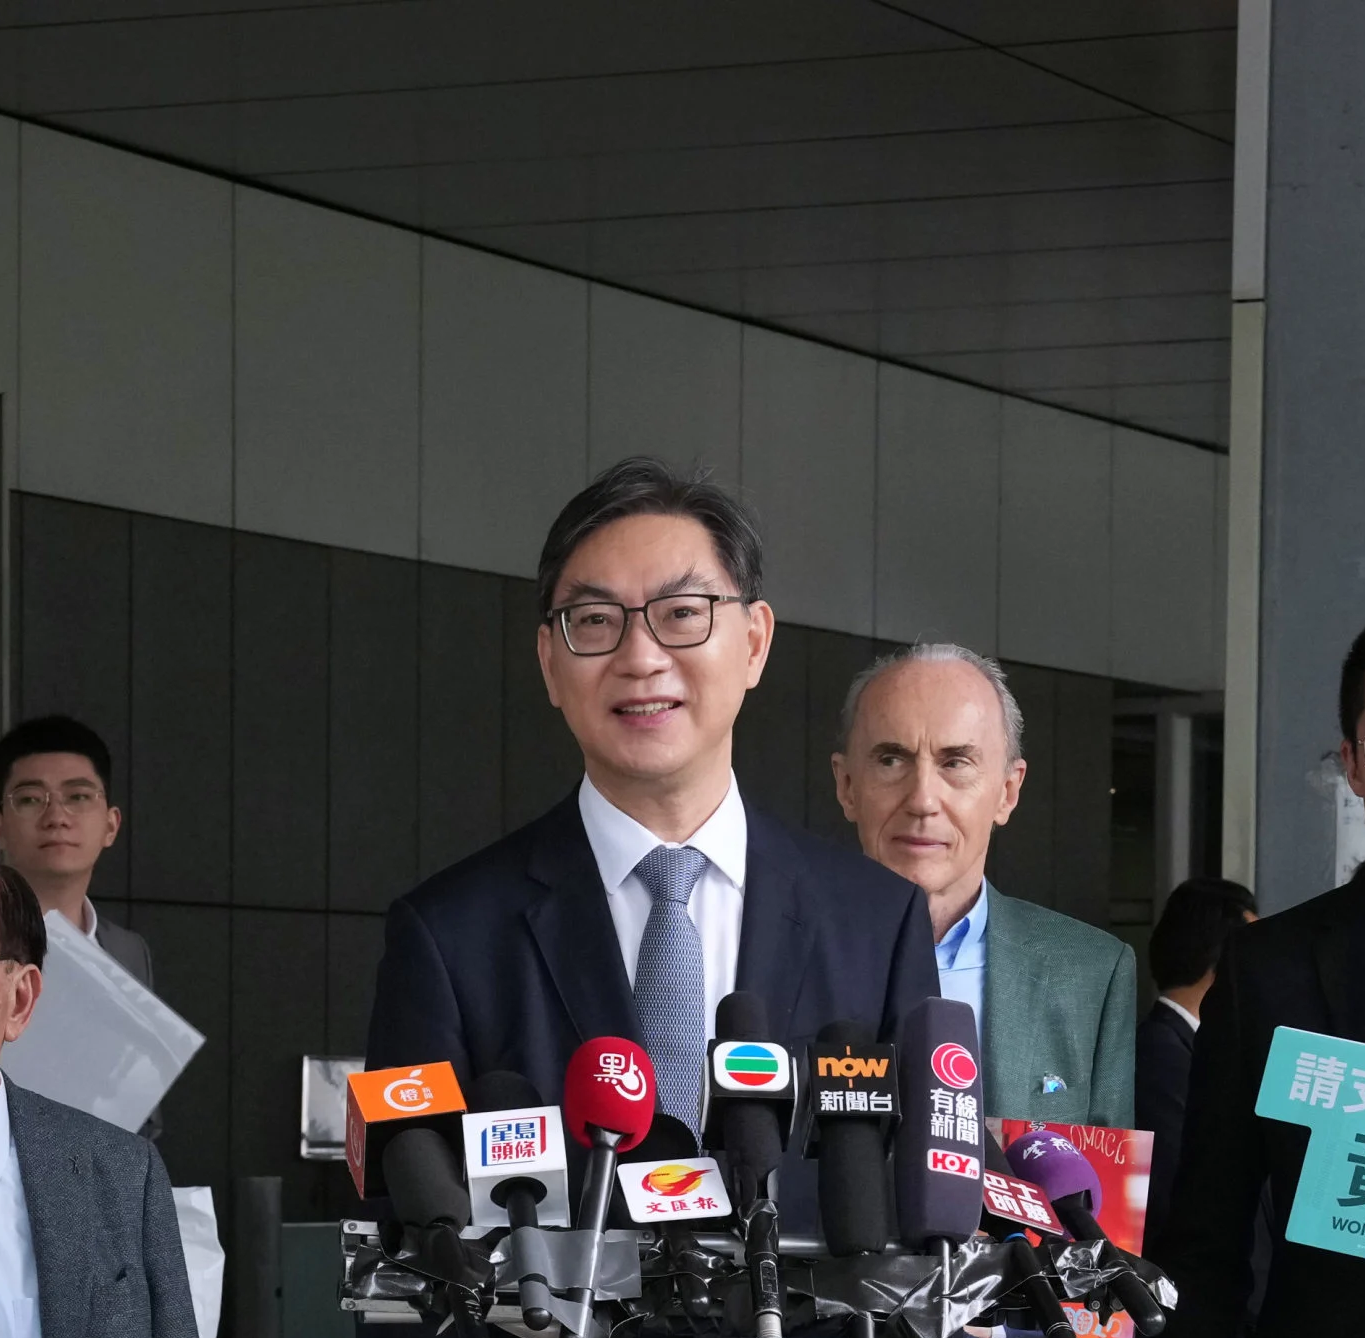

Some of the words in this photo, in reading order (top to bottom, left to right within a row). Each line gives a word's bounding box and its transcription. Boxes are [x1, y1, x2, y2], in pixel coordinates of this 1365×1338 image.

[817, 1055, 889, 1079] now
[820, 1090, 893, 1112] 新聞台
[930, 1088, 978, 1121] 有線
[492, 1122, 535, 1142] 星島
[931, 1112, 978, 1146] 新聞
[492, 1141, 536, 1162] 頭條
[932, 1151, 971, 1174] HOY
[984, 1173, 1042, 1205] 巴士
[647, 1196, 718, 1214] 文匯報
